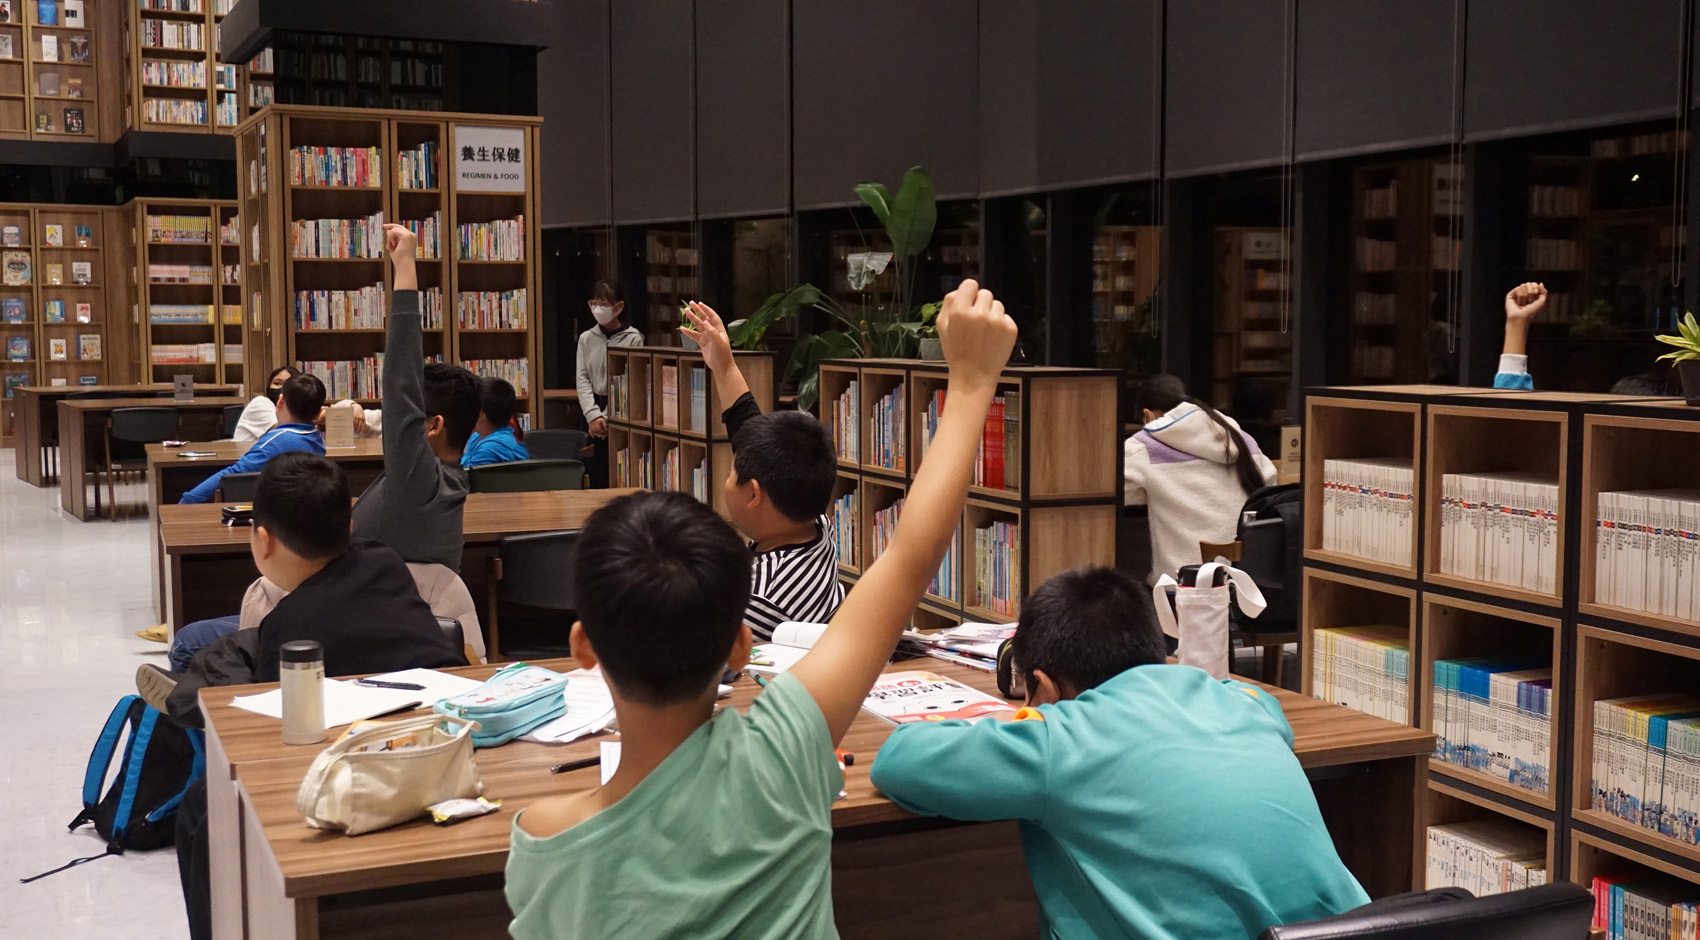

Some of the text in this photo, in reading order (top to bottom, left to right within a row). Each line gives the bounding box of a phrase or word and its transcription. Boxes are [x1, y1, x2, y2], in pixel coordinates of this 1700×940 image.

[461, 145, 521, 163] 養生保健
[493, 172, 499, 180] &
[501, 172, 520, 180] FOOD
